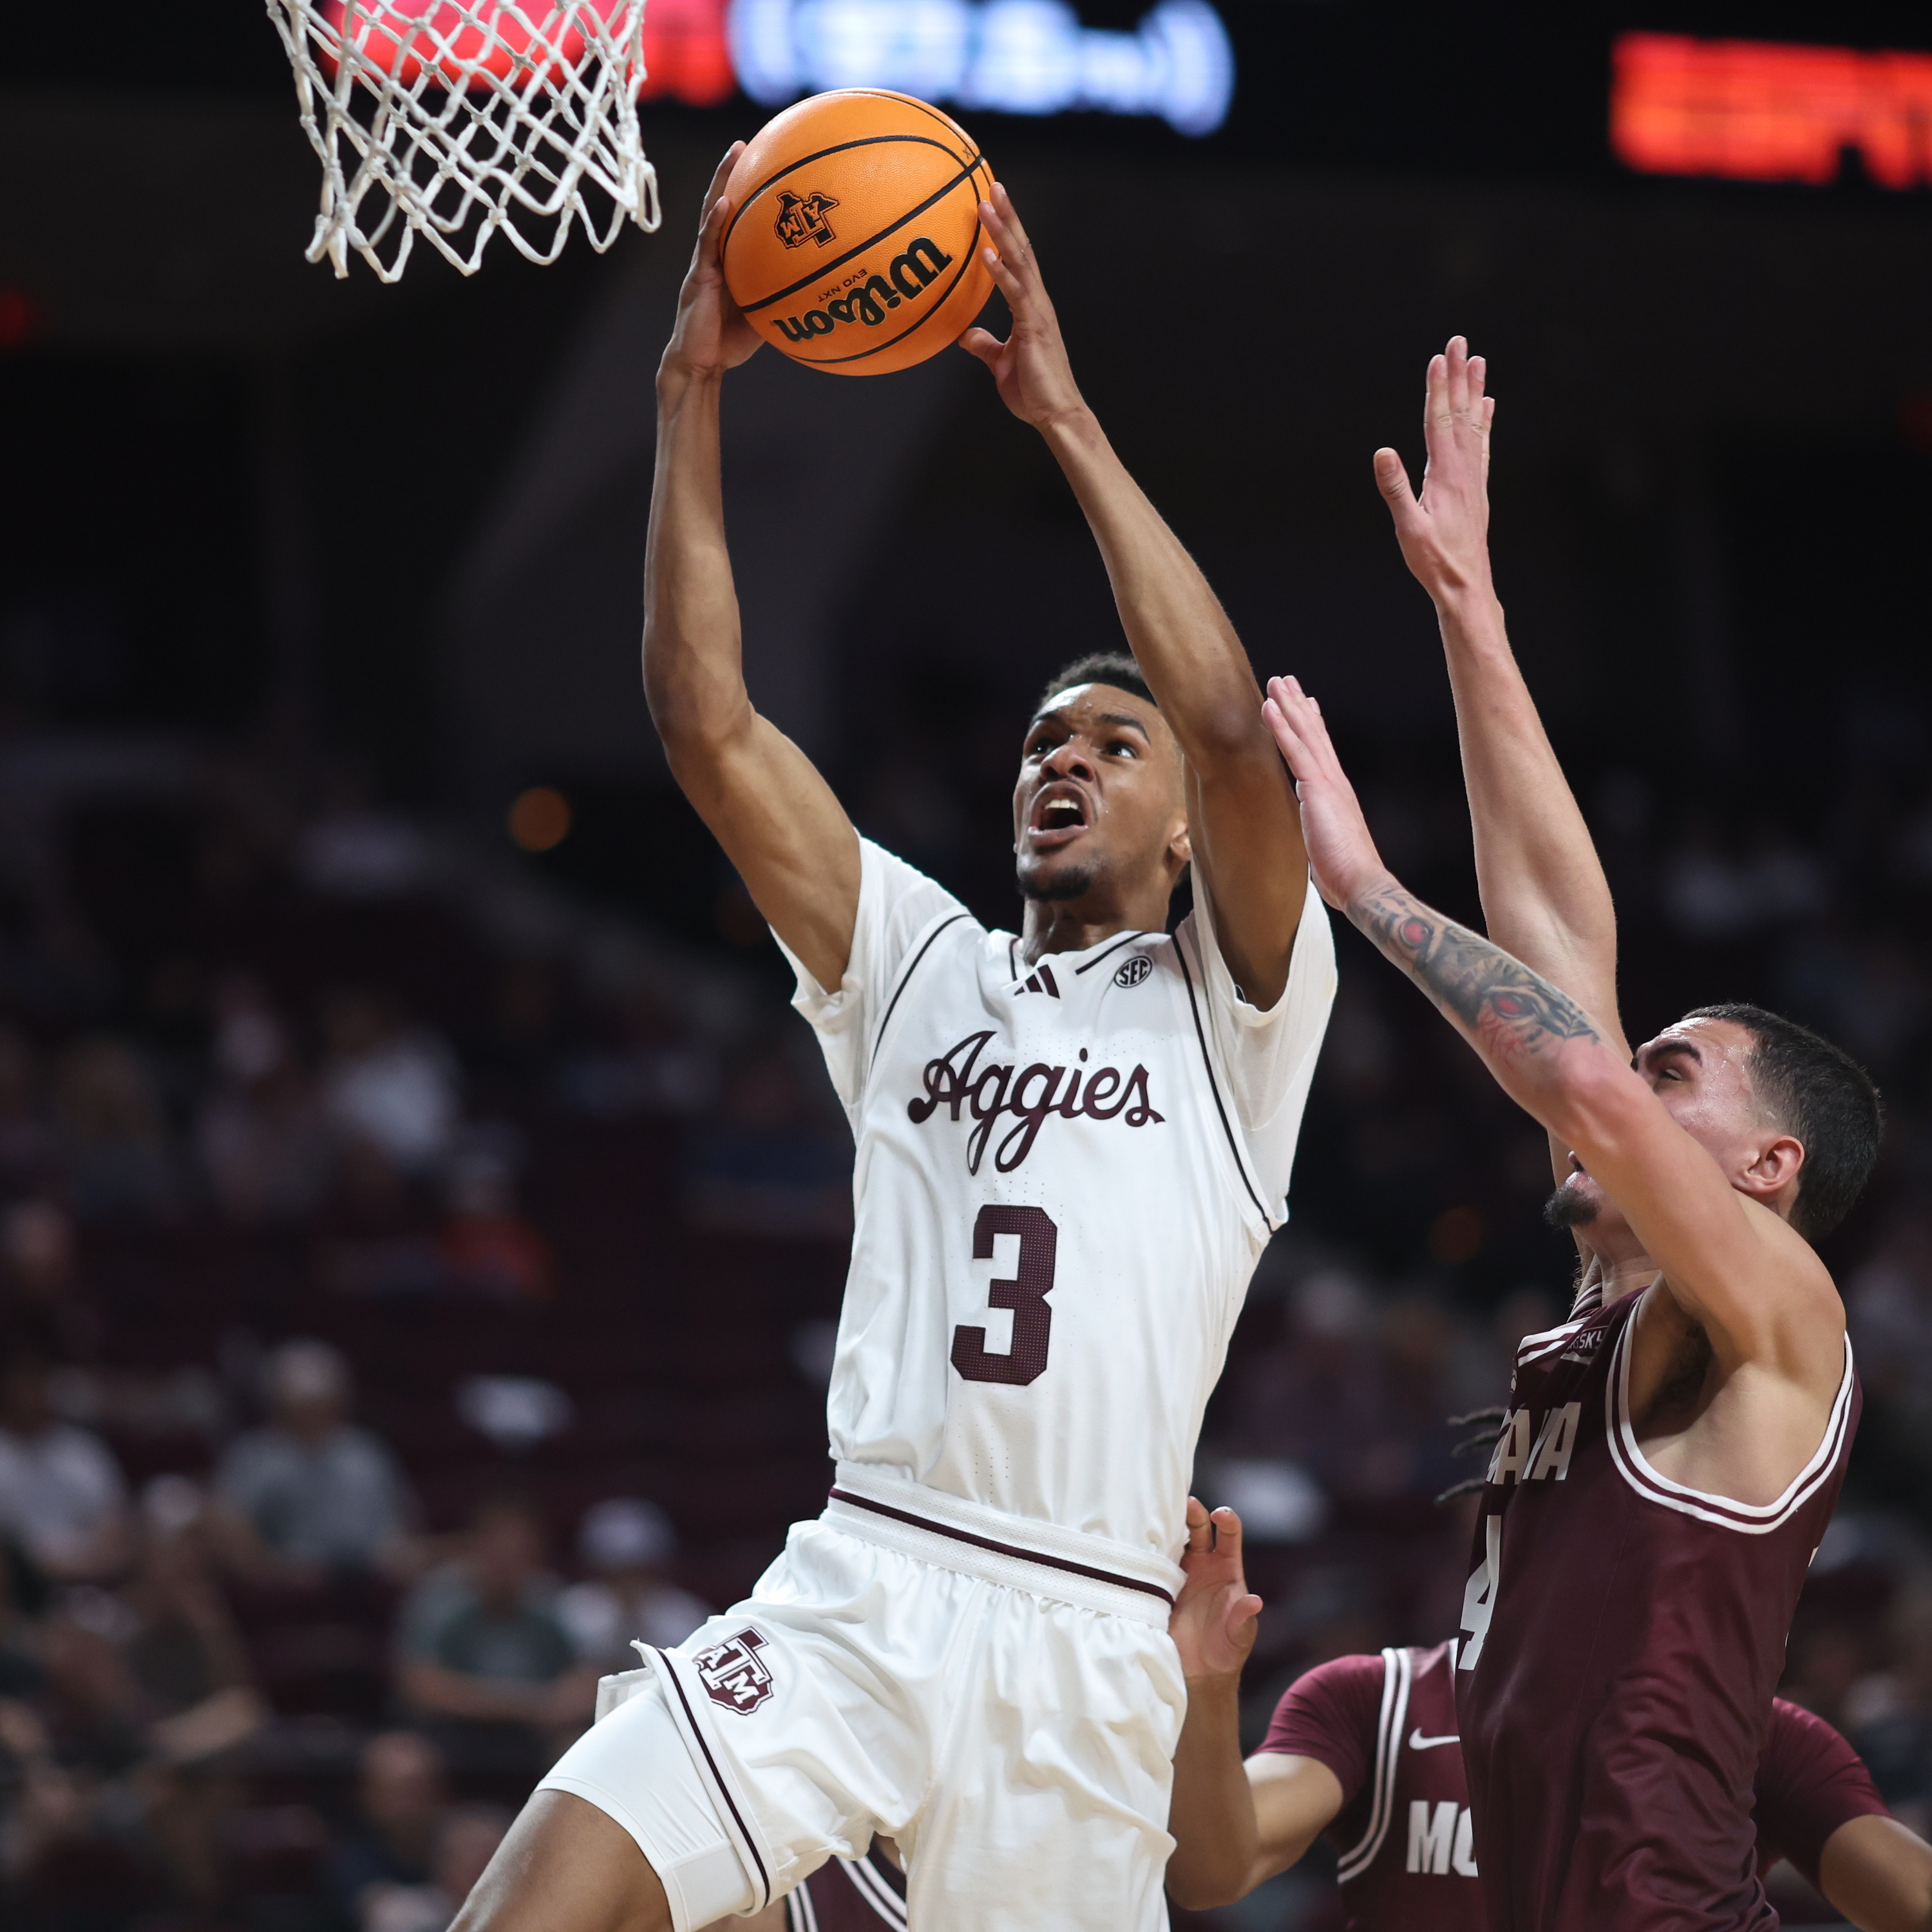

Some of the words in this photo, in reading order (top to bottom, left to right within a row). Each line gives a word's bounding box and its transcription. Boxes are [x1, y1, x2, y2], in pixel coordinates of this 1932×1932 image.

[772, 236, 953, 343] Wilson
[818, 285, 841, 303] NXT
[842, 269, 867, 287] EVO
[1118, 959, 1148, 985] SEC
[907, 1030, 1166, 1177] Aggies
[950, 1204, 1058, 1387] 3
